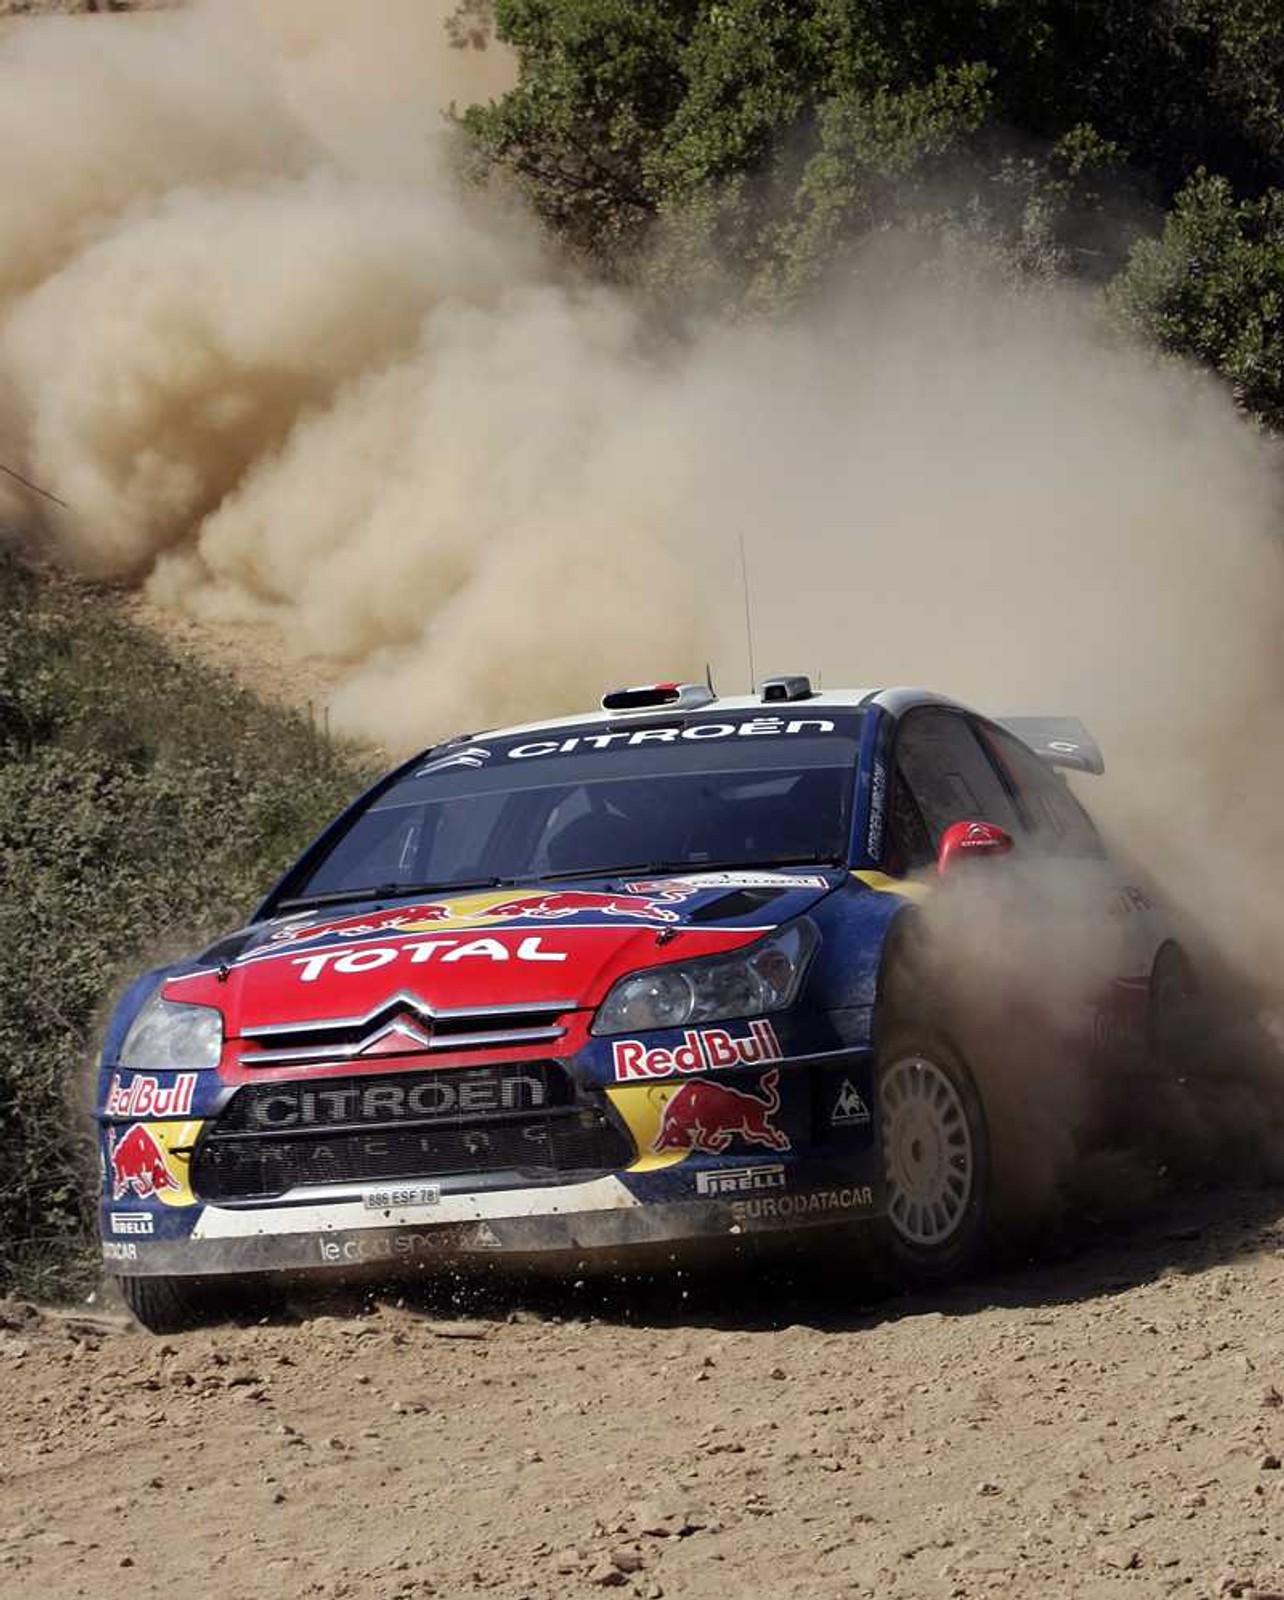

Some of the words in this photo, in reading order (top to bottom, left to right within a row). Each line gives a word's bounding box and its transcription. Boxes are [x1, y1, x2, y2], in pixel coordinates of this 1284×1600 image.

[292, 937, 567, 982] TOTAL
[613, 1030, 706, 1081] Red
[701, 1019, 783, 1068] Bull
[132, 1073, 197, 1117] Bull
[696, 1164, 785, 1196] PIRELLI
[731, 1187, 873, 1218] EURODATACAR
[111, 1213, 154, 1233] PIRELLI
